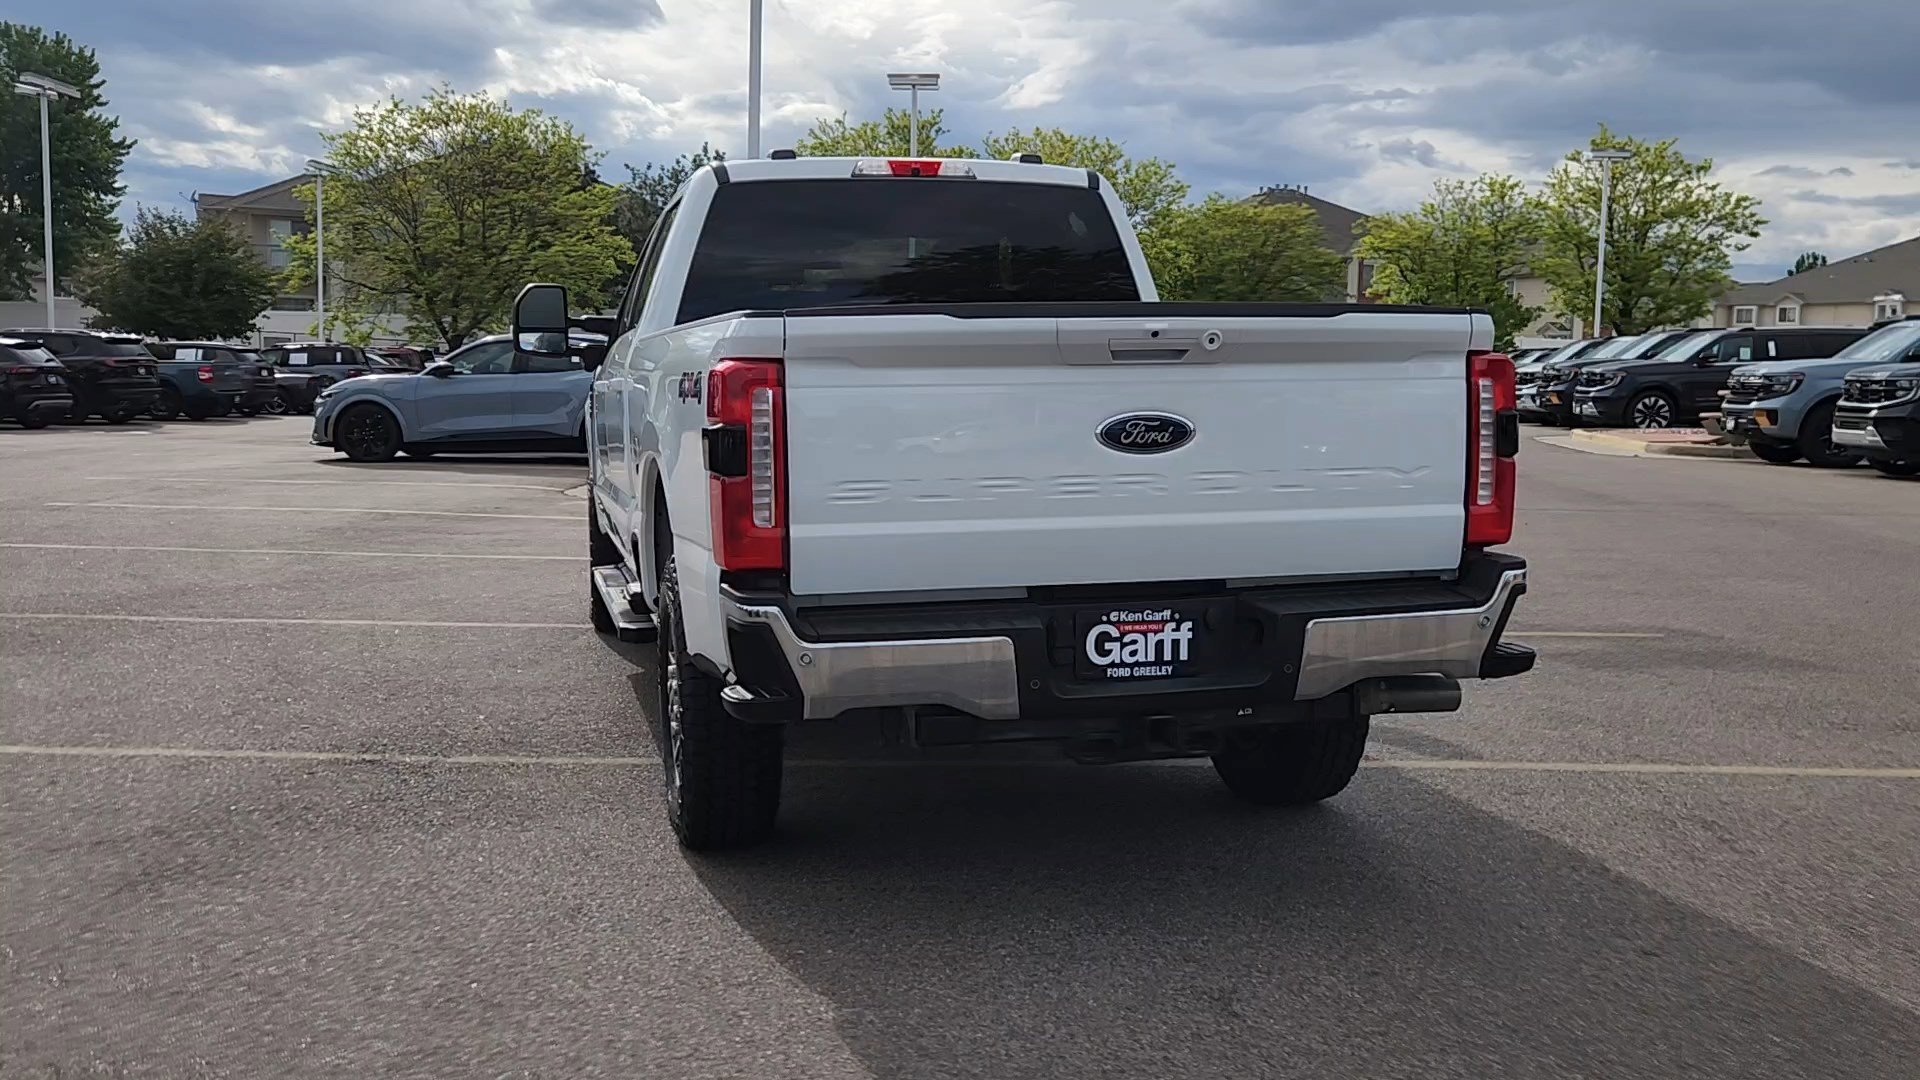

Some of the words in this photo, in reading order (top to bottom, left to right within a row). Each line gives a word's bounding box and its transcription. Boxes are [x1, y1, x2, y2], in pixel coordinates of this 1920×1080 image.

[1121, 420, 1174, 444] Ford
[1120, 611, 1143, 621] Ken
[1143, 609, 1172, 621] Garff
[1086, 621, 1193, 665] Garff
[1107, 667, 1131, 677] FORD
[1133, 665, 1173, 677] GREELEY
